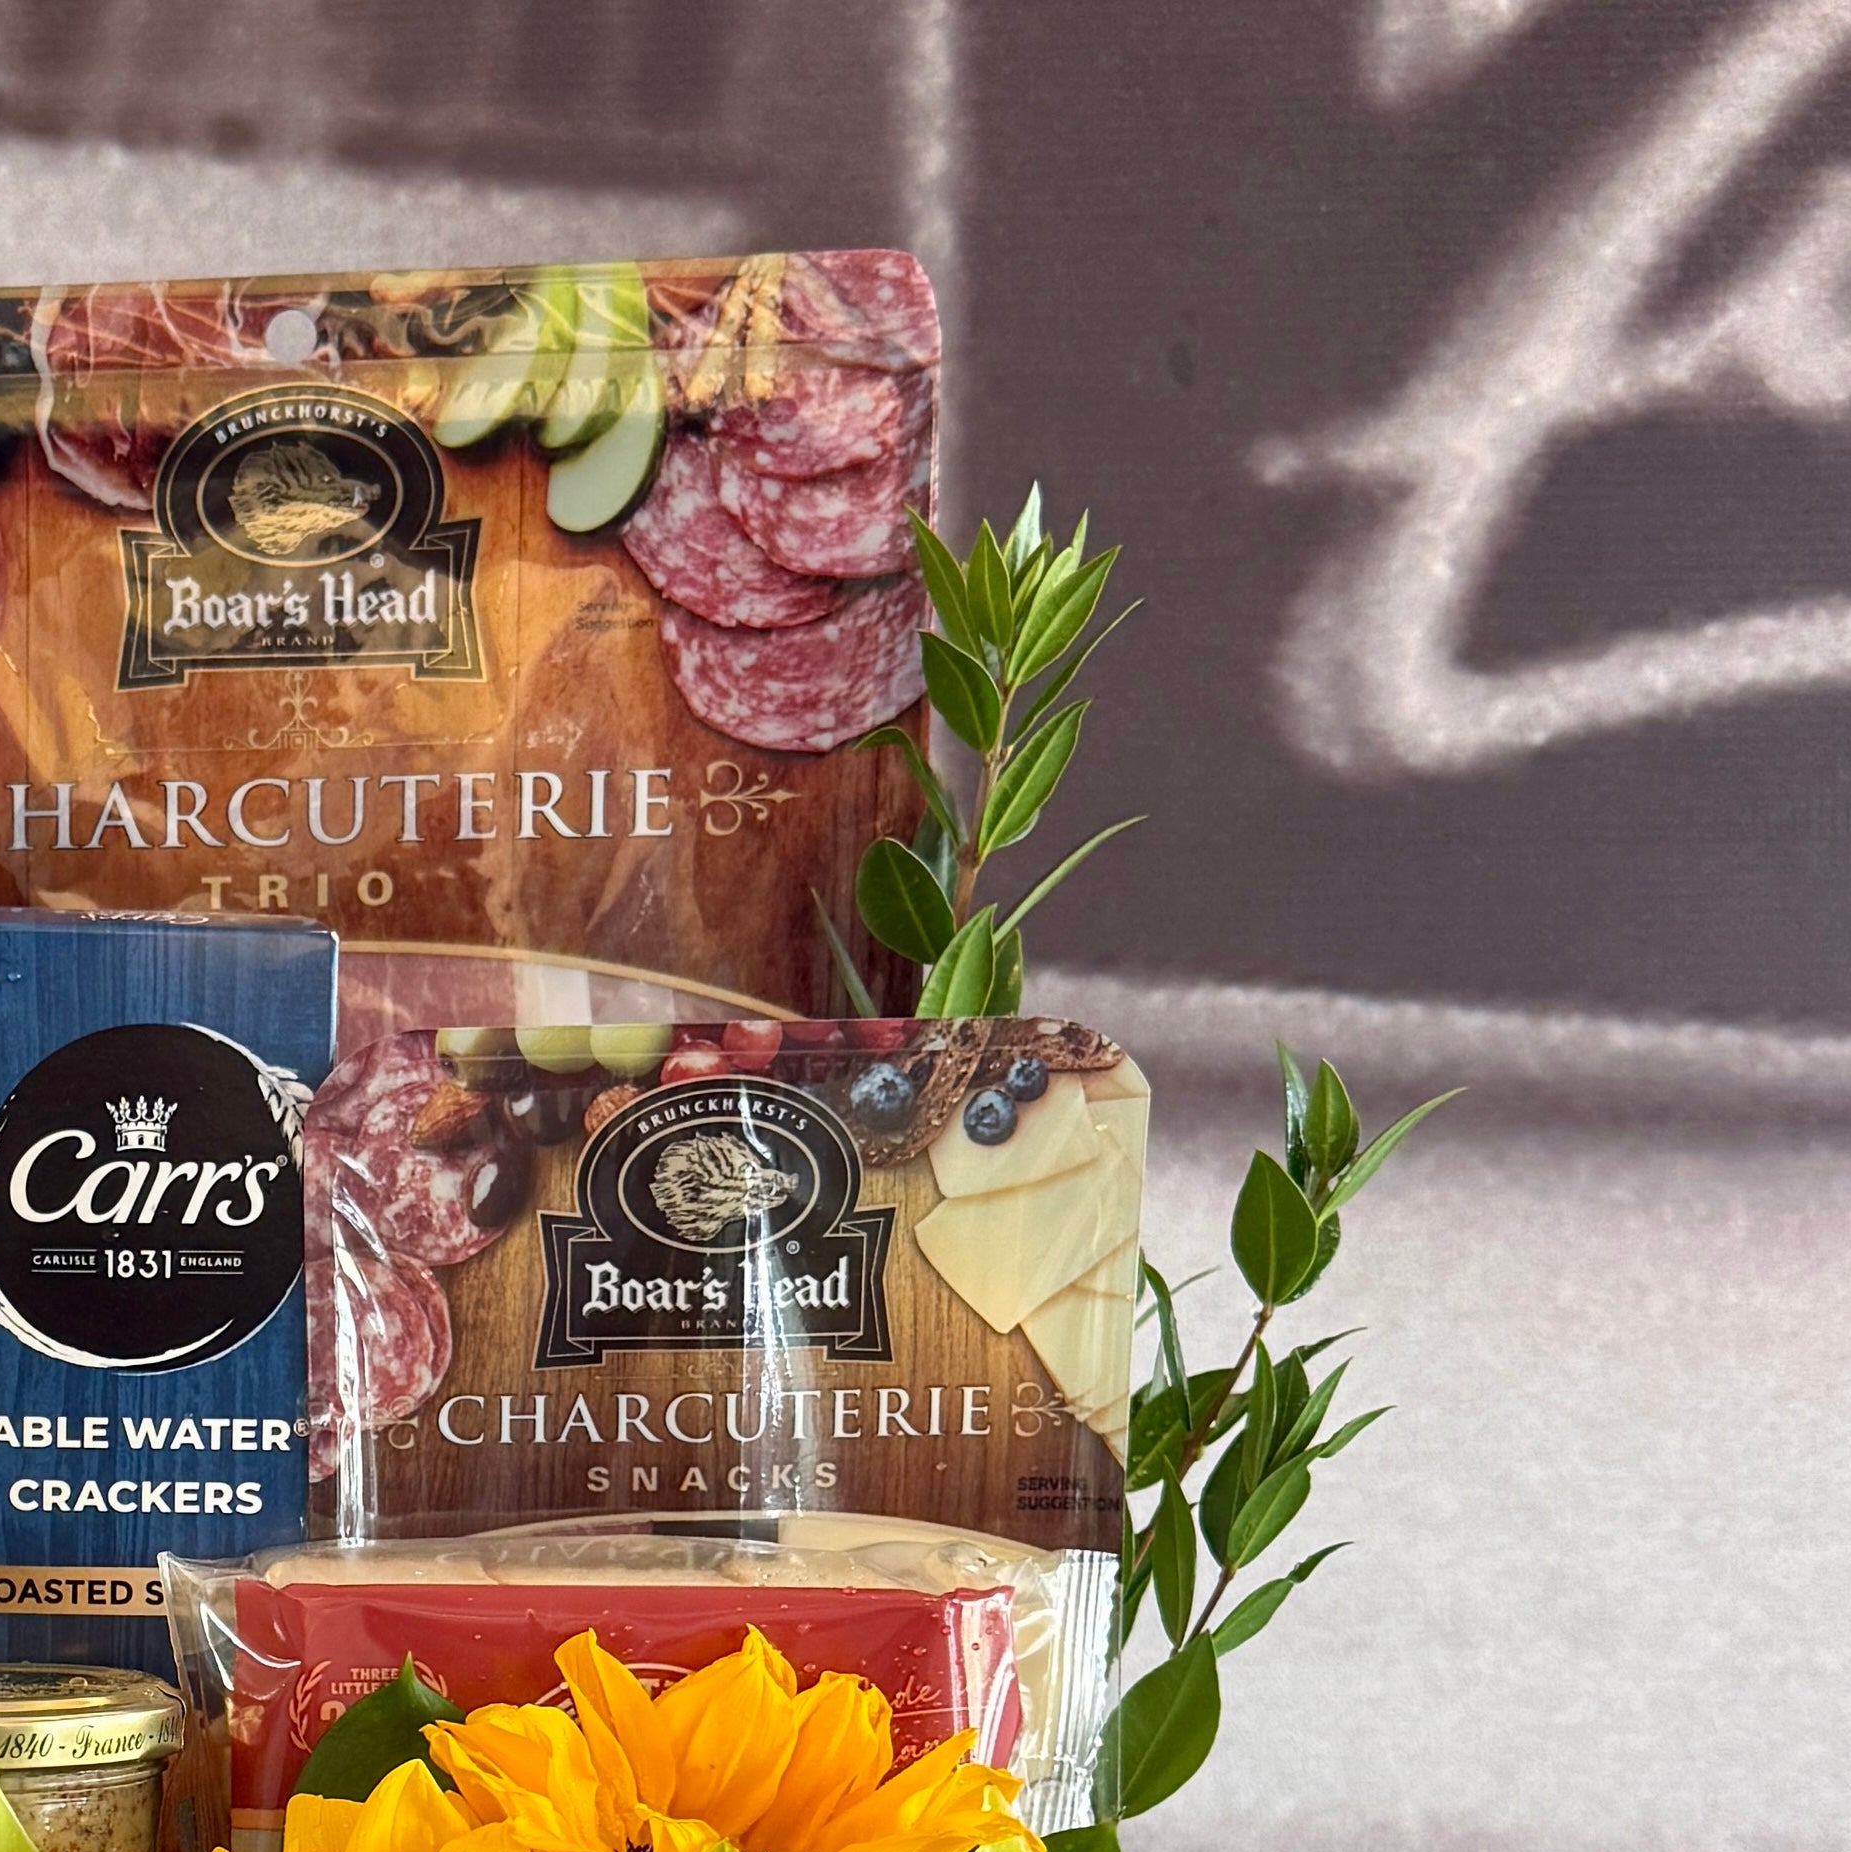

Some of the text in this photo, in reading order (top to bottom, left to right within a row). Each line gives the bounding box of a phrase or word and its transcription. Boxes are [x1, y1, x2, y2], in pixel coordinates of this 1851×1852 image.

[214, 404, 388, 446] BRUNCKHORST'S
[162, 569, 437, 635] Boar's Head
[261, 635, 335, 648] BRAND
[201, 870, 394, 909] TRIO
[637, 1097, 809, 1135] BRUNCKHORST'S
[9, 1129, 280, 1227] Carr's
[32, 1249, 243, 1279] CARLISLE 1831 ENGLAND
[581, 1260, 730, 1318] Boar's
[681, 1319, 757, 1331] BRAN
[437, 1383, 993, 1448] CHARCUTERIE
[122, 1416, 291, 1452] WATER
[586, 1462, 838, 1493] SNACKS
[8, 1479, 263, 1515] CRACKERS
[350, 1667, 399, 1680] THREE
[72, 1725, 146, 1759] France
